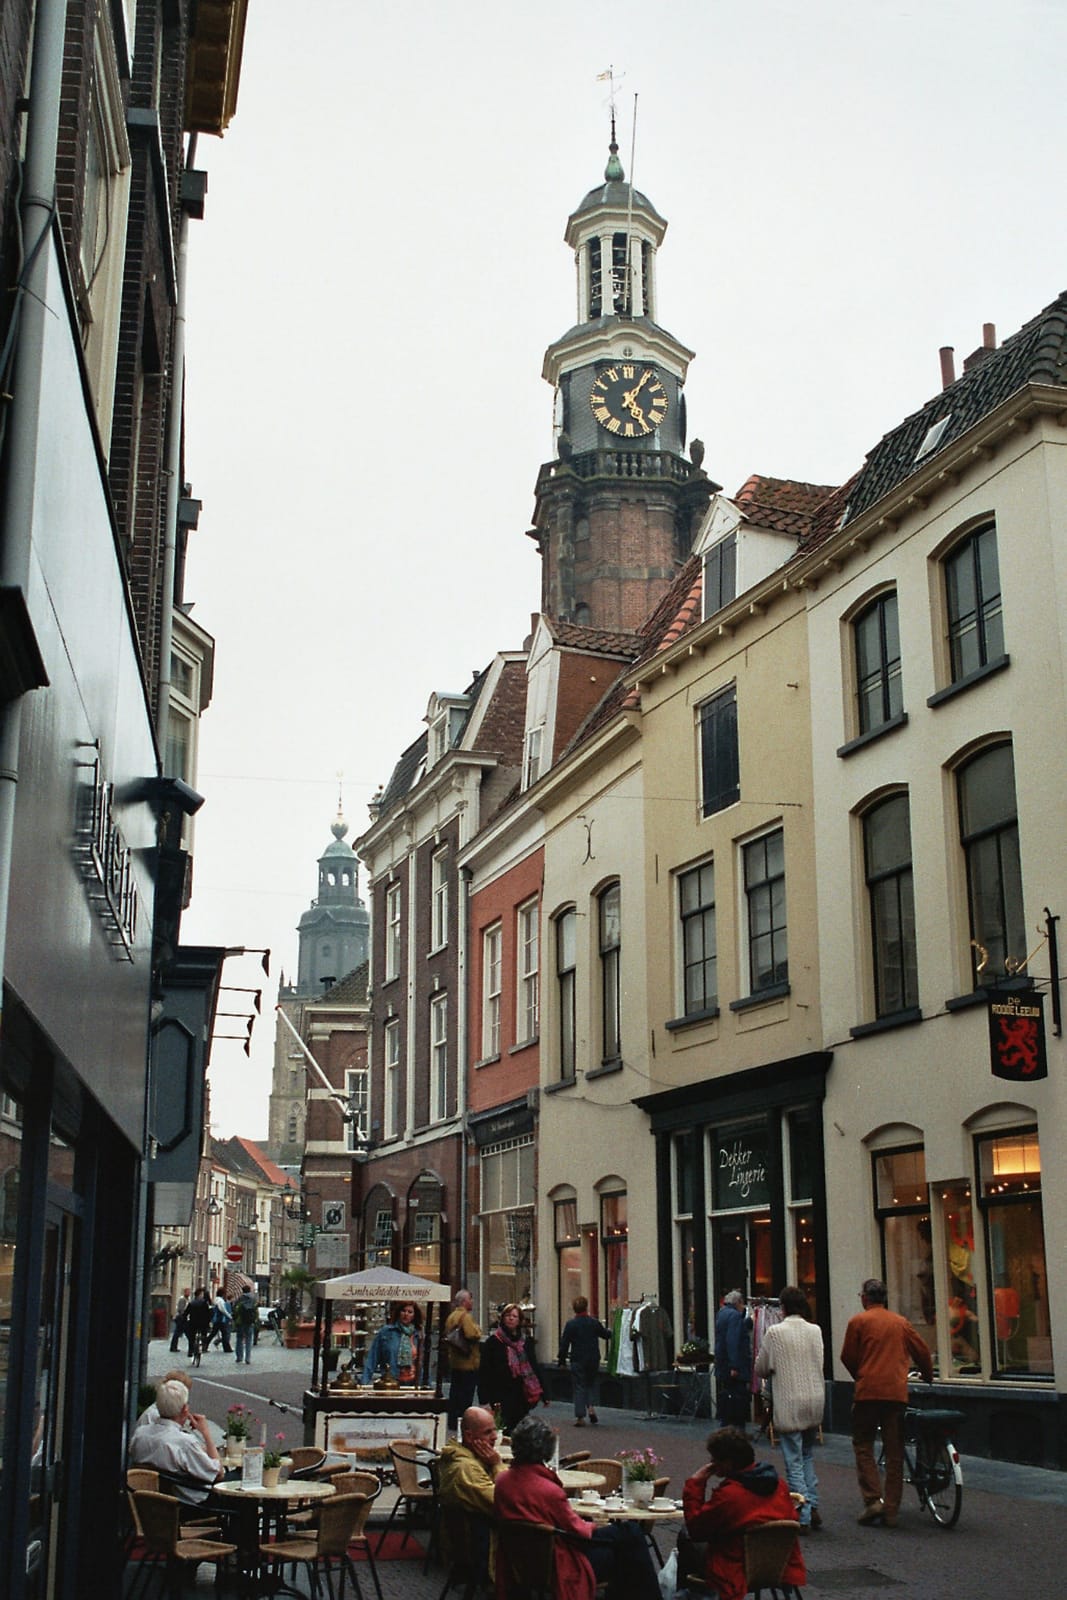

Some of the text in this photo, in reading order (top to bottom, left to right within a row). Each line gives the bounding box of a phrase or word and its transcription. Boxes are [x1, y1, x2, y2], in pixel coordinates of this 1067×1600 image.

[719, 1140, 752, 1168] Dekker
[728, 1163, 766, 1198] Lingerie
[342, 1285, 431, 1300] Ambachtelijk roomijs
